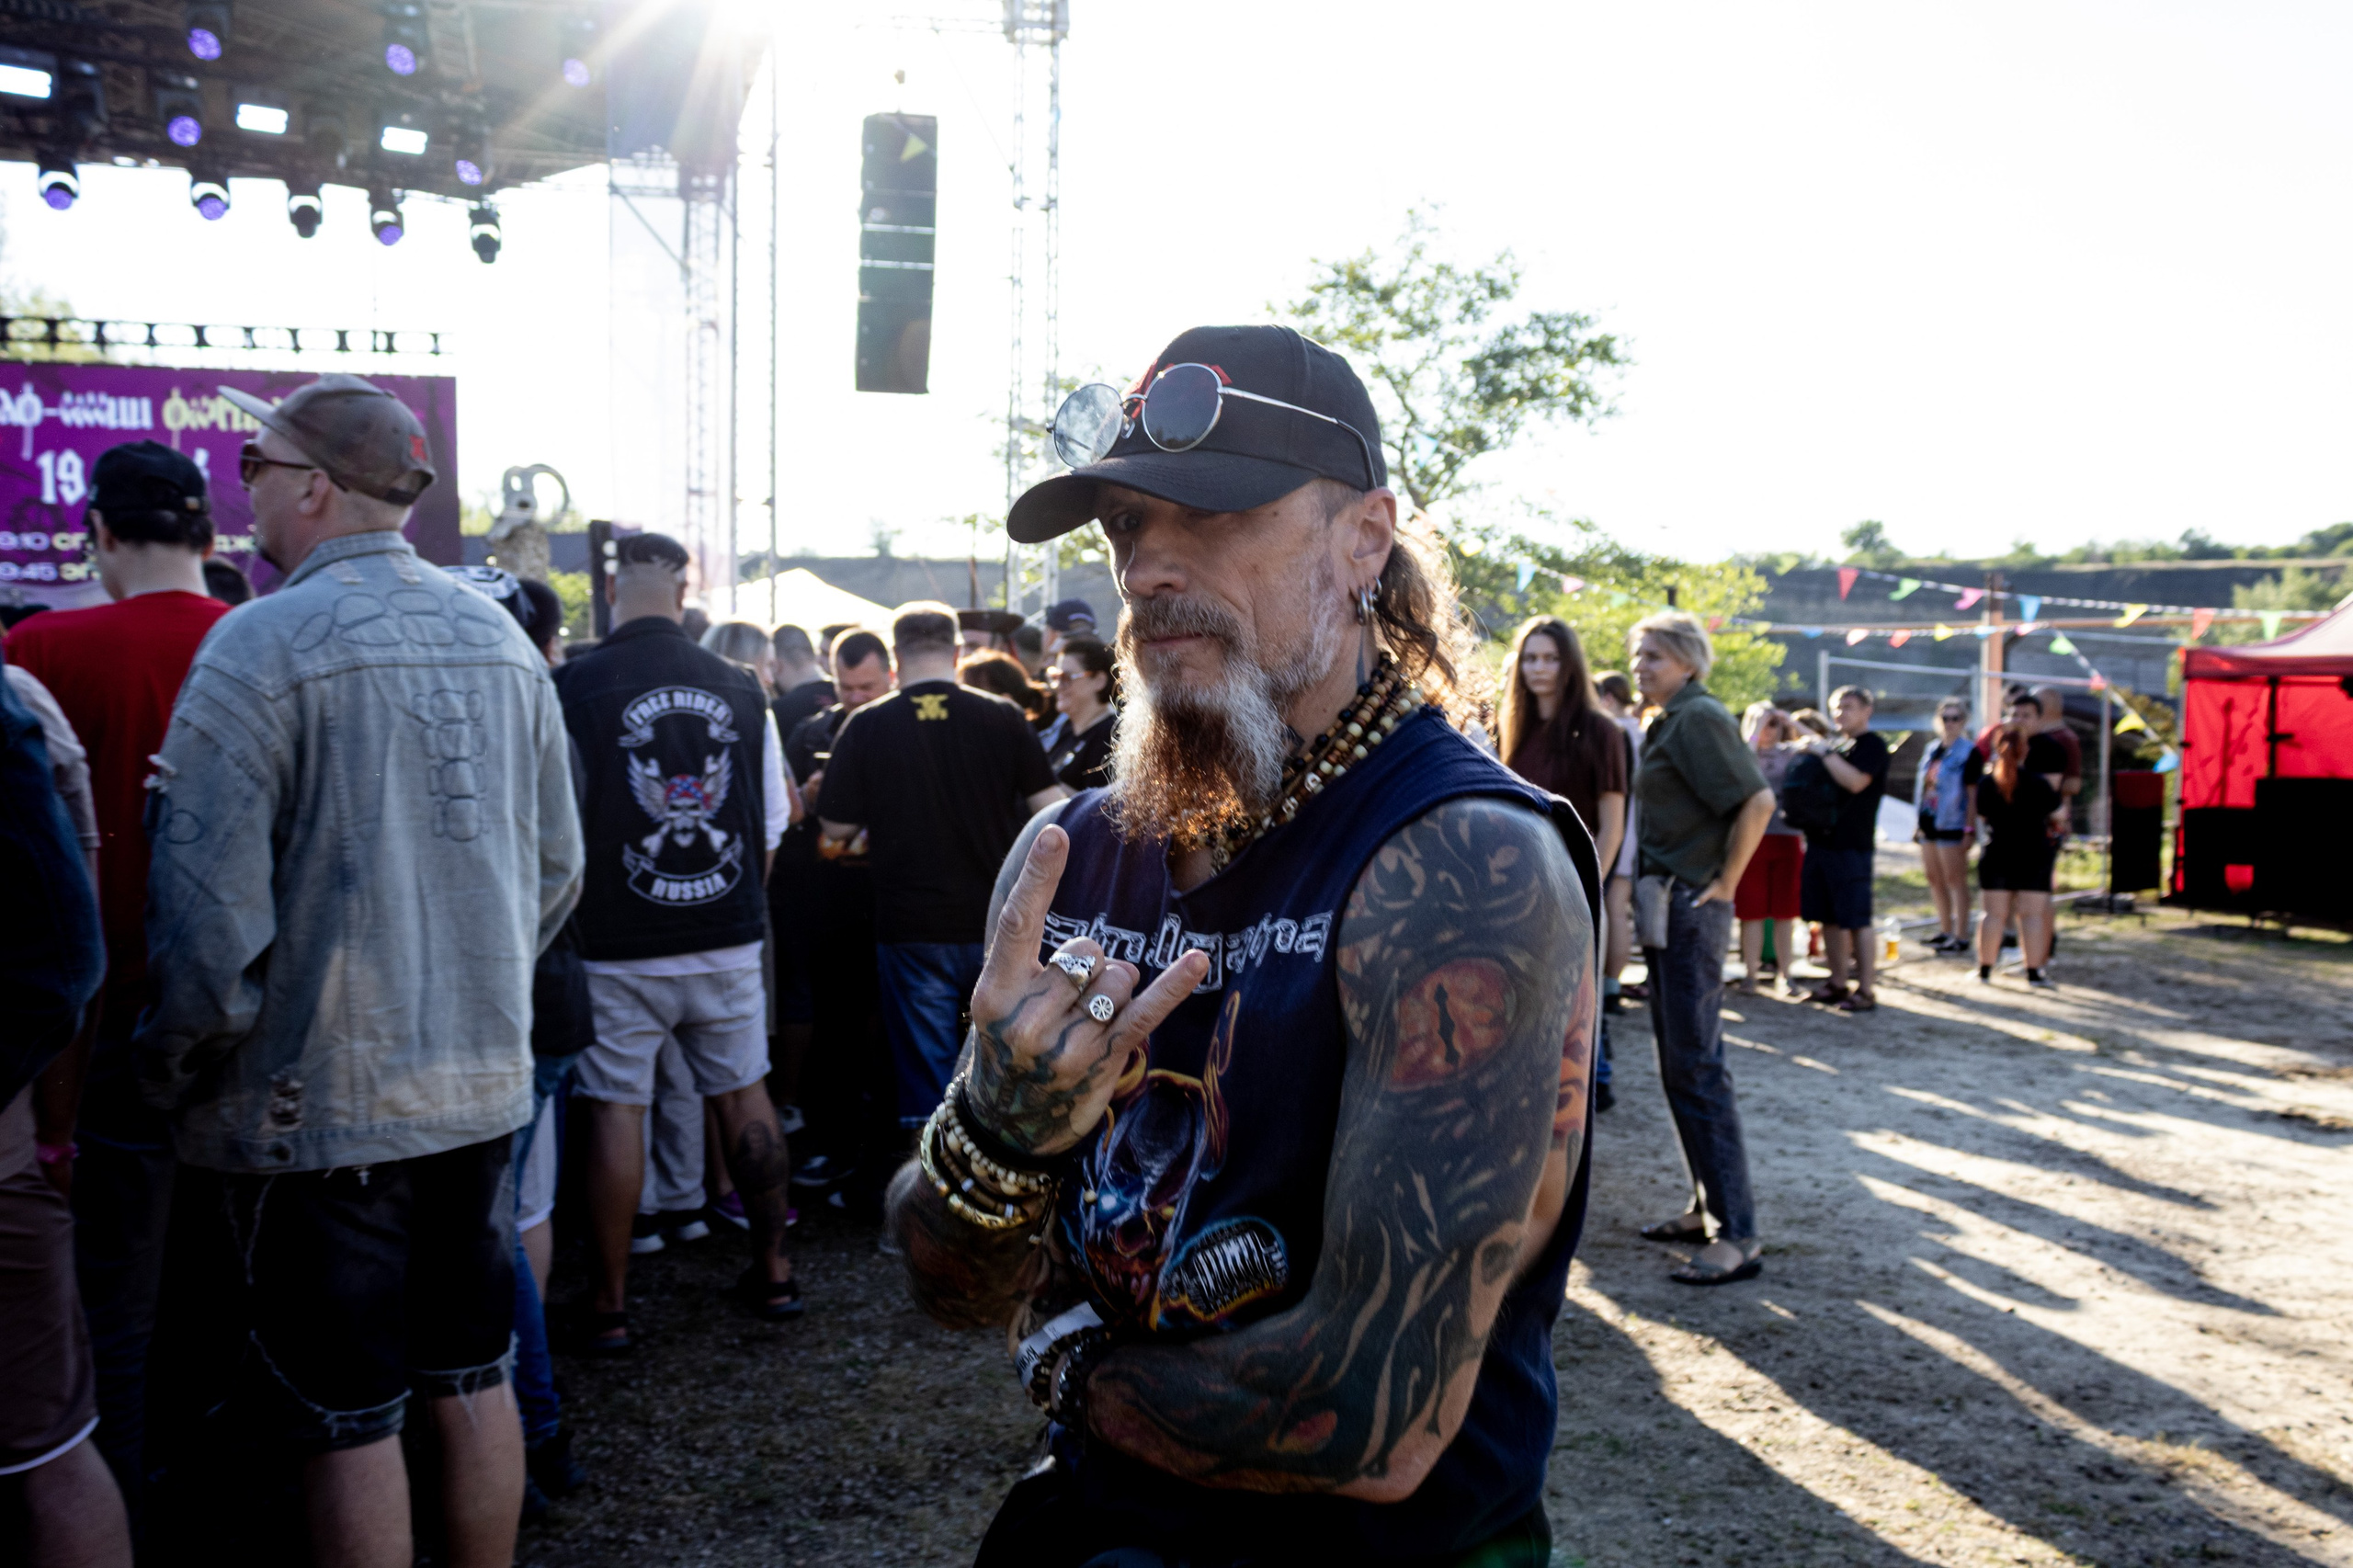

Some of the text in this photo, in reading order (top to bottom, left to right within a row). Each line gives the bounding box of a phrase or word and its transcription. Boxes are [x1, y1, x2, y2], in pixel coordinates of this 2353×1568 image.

[36, 449, 87, 506] 19
[629, 691, 671, 725] FREE
[650, 872, 728, 901] RUSSIA
